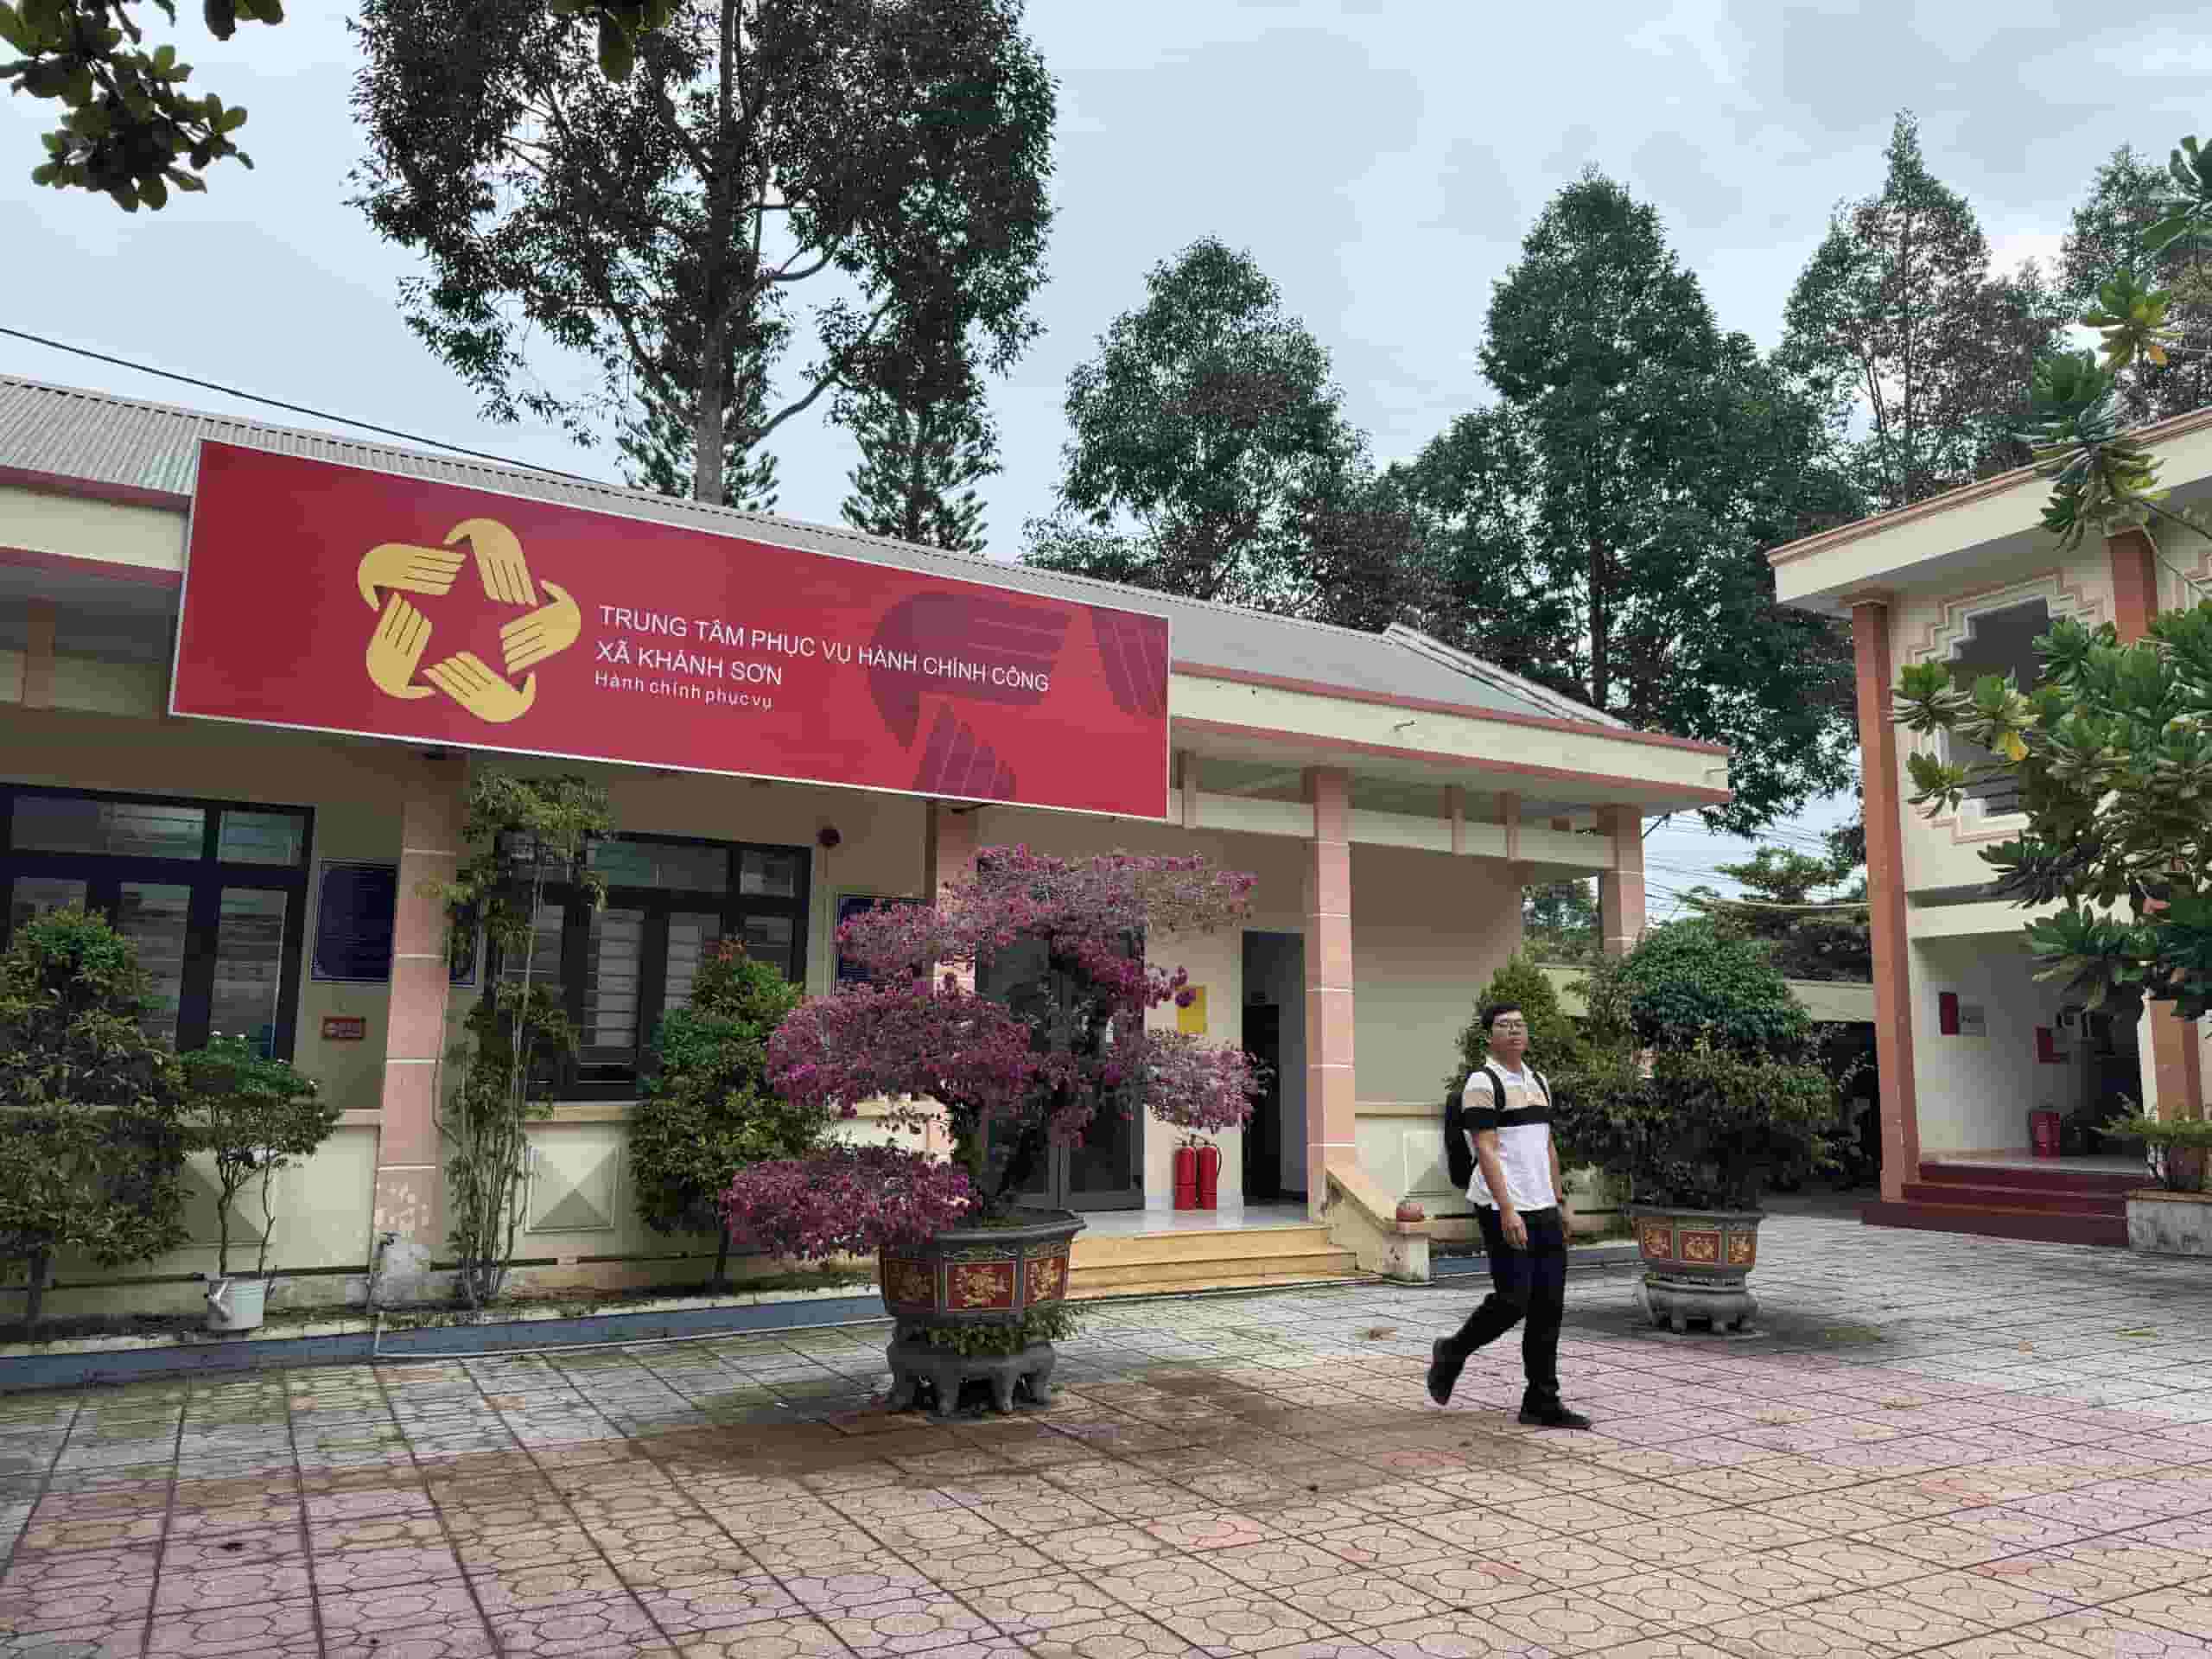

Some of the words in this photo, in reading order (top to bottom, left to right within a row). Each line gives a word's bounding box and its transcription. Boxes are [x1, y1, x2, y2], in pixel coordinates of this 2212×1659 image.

[595, 637, 631, 664] XÃ
[638, 647, 723, 678] KHÁNH
[730, 661, 782, 685] SƠN
[599, 605, 688, 637] TRUNG
[694, 620, 744, 647] TÂM
[751, 629, 817, 658] PHỤC
[822, 640, 851, 664] VỤ
[858, 644, 918, 672] HÀNH
[923, 656, 986, 682] CHÍNH
[992, 665, 1050, 692] CÔNG
